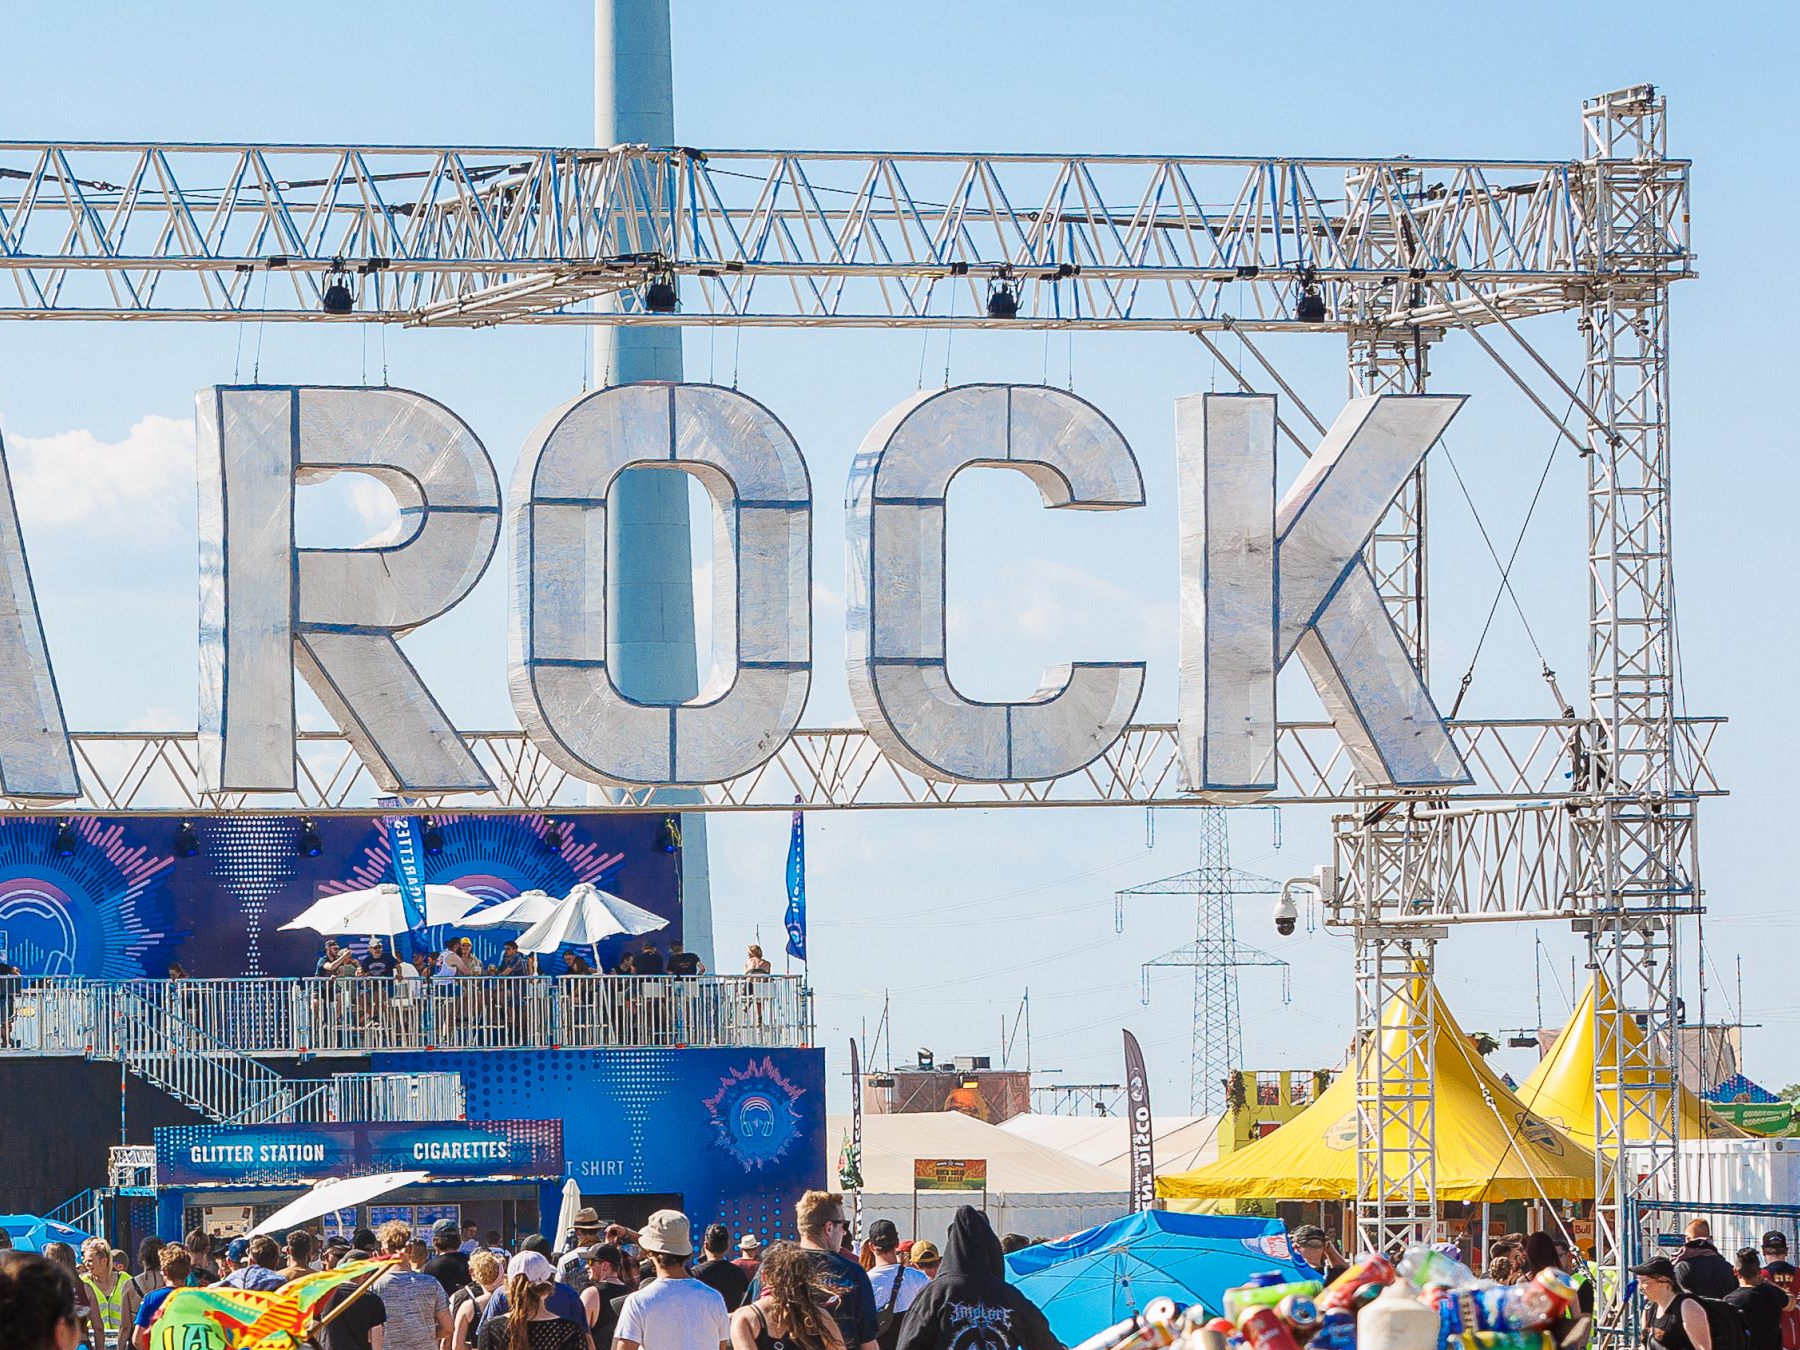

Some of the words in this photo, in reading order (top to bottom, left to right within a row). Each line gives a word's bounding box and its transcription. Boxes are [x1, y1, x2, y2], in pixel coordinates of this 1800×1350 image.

[196, 381, 1473, 793] ROCK
[190, 1144, 254, 1163] GLITTER
[260, 1143, 325, 1162] STATION
[413, 1141, 508, 1160] CIGARETTES
[566, 1160, 625, 1176] T-SHIRT
[1575, 1223, 1591, 1234] Bull
